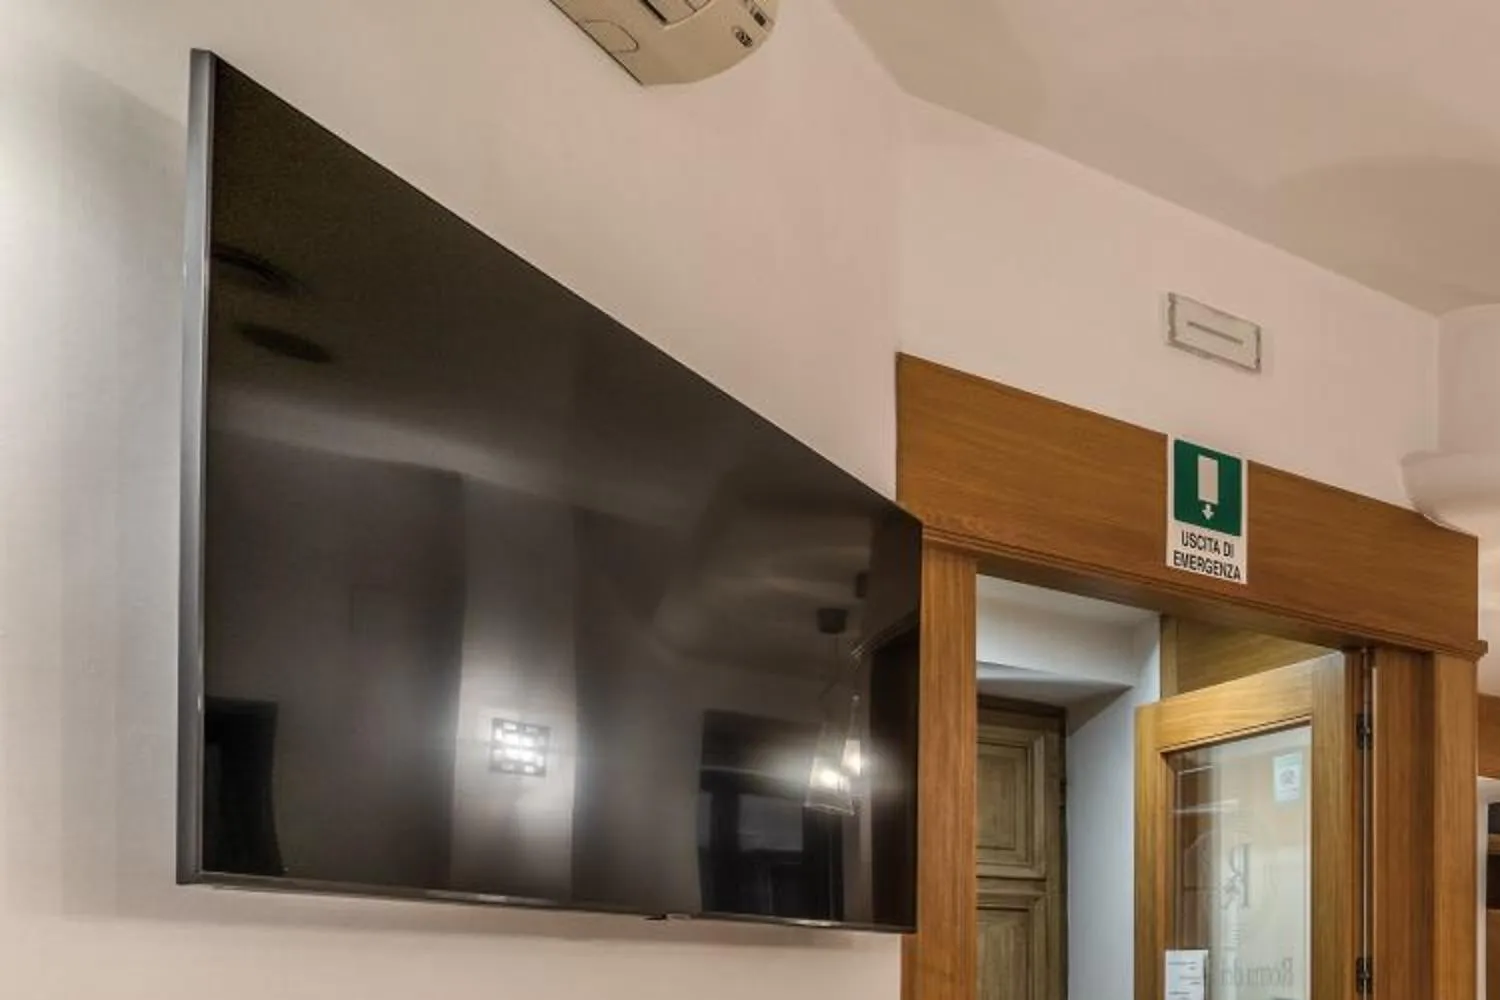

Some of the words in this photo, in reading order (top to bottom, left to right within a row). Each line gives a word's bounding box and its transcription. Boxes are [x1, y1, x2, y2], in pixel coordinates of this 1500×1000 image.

[1181, 531, 1220, 555] USCITA
[1223, 542, 1235, 558] DI
[1173, 550, 1241, 580] EMERGENZA
